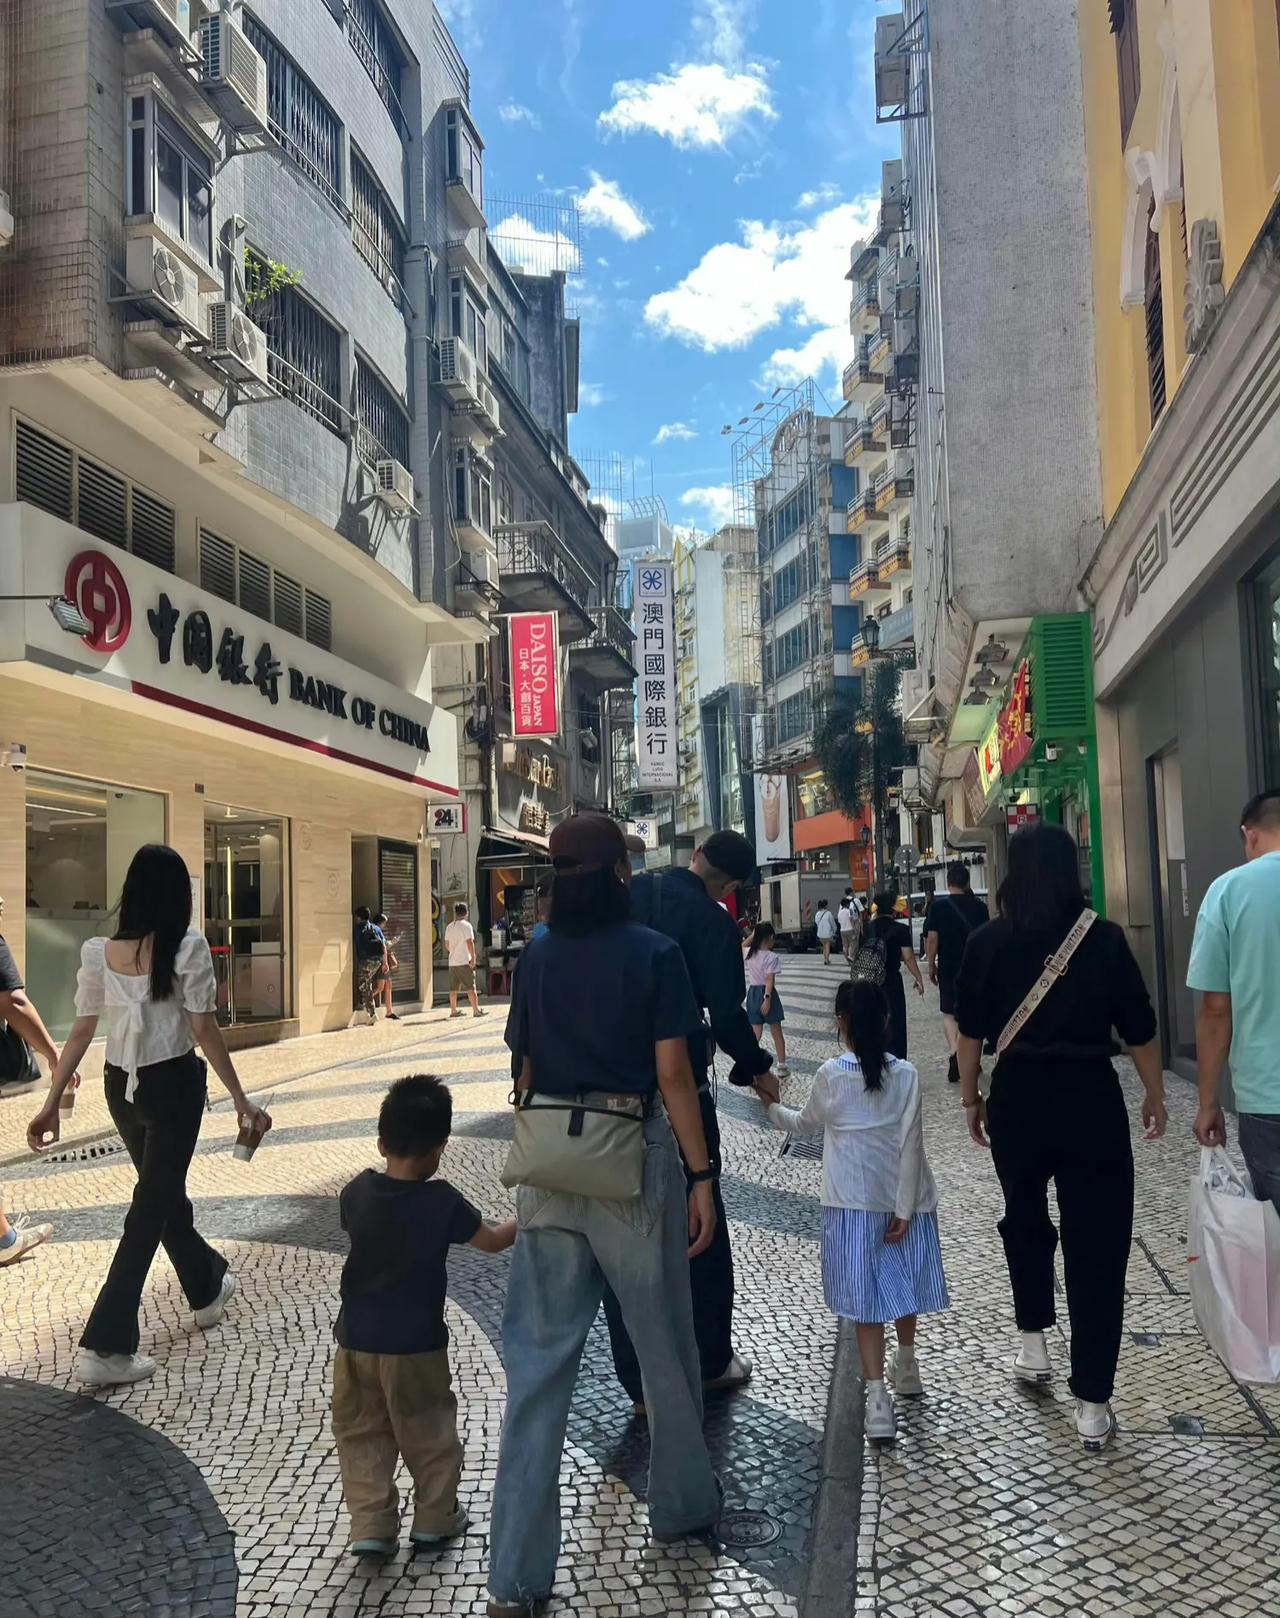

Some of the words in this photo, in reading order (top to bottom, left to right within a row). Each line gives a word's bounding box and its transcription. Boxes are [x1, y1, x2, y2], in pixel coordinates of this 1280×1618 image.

[530, 622, 548, 693] DAISO
[642, 602, 668, 754] 澳門國際銀行
[288, 667, 347, 719] BANK
[351, 697, 376, 729] OF
[379, 708, 430, 752] CHINA
[532, 694, 542, 726] JAPAN
[435, 808, 454, 827] 24
[1062, 924, 1086, 954] VUITTON
